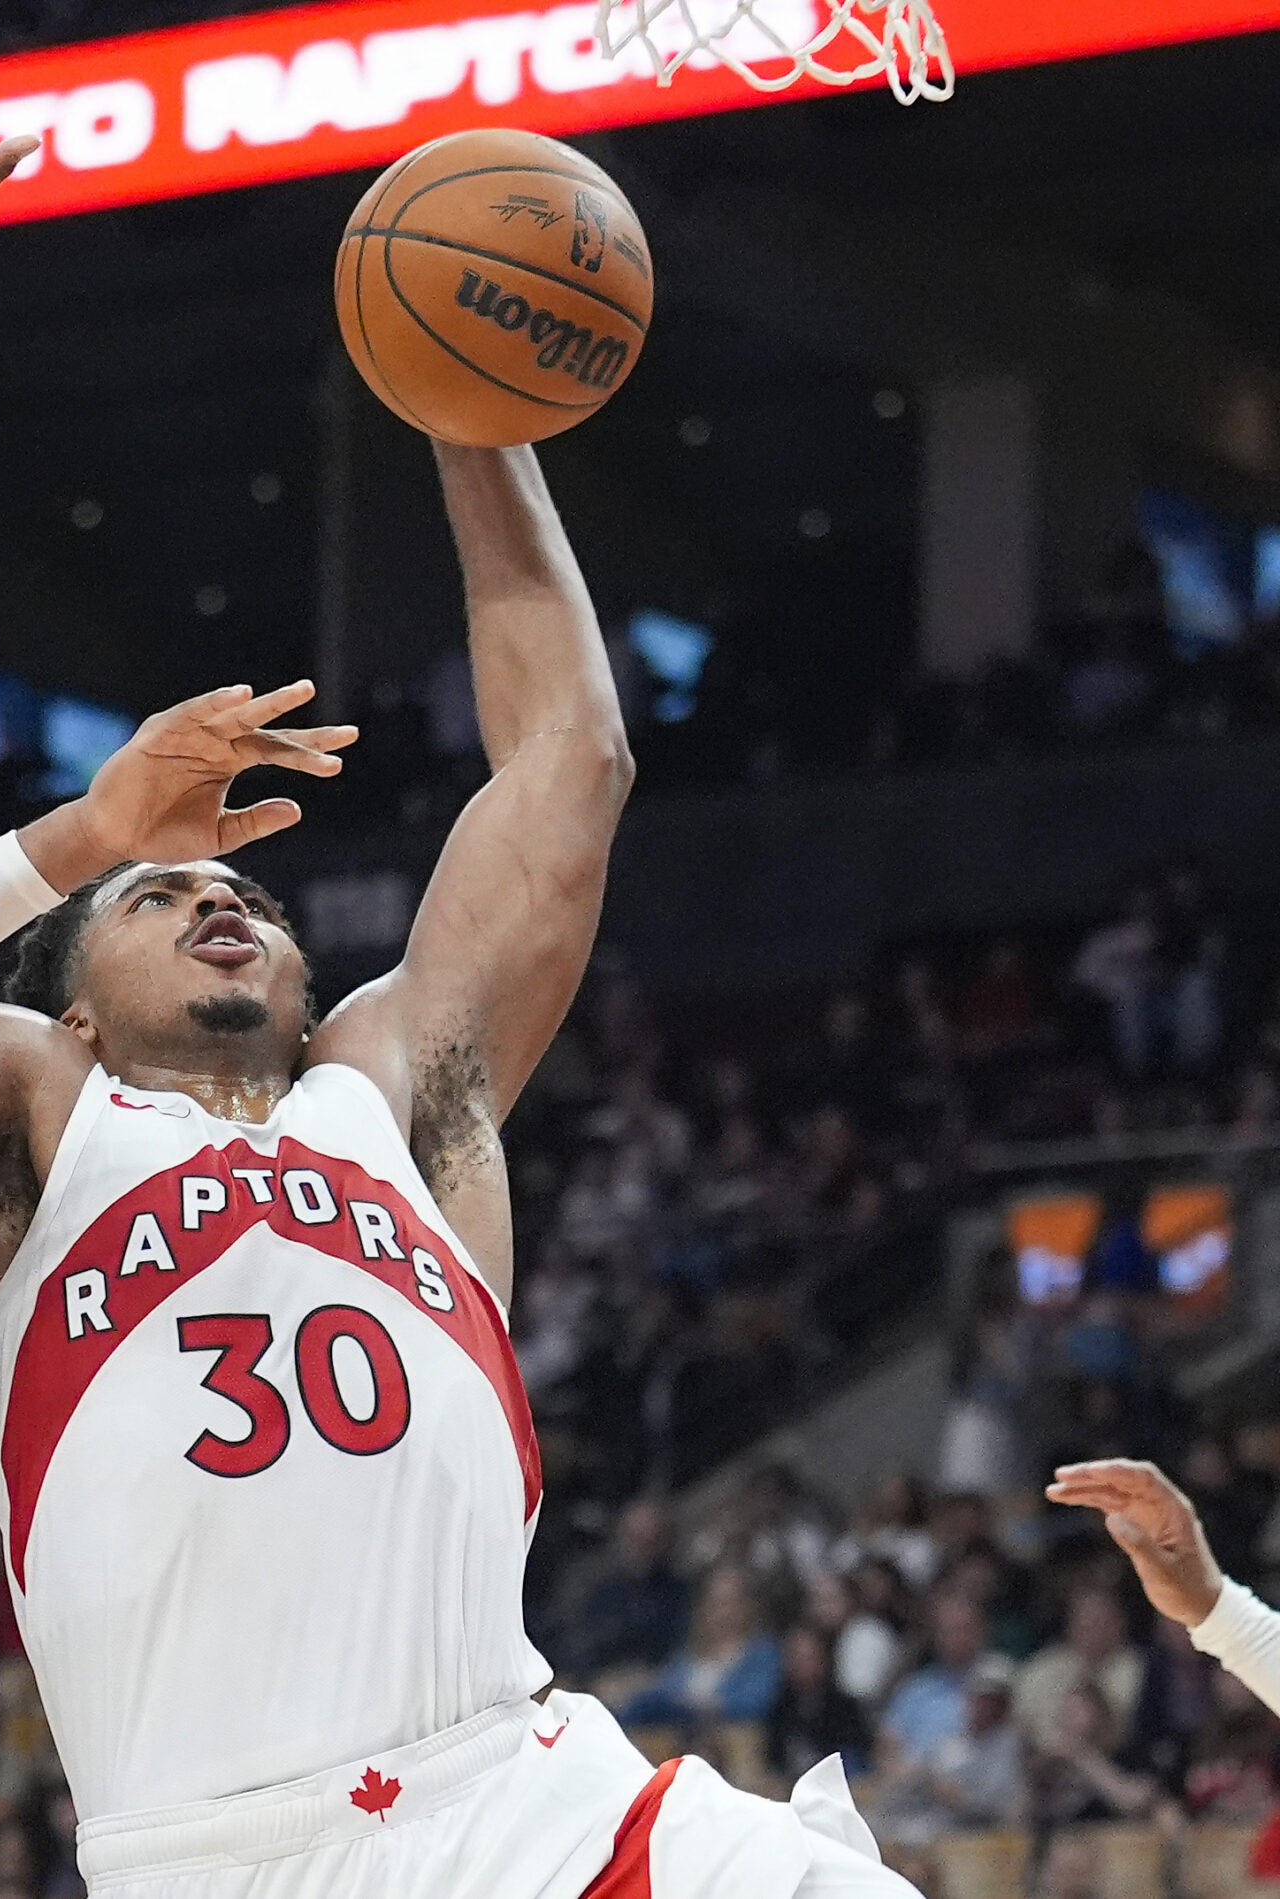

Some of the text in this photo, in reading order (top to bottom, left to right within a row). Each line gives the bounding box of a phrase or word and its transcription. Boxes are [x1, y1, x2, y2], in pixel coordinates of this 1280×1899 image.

[455, 267, 629, 389] Wilson
[63, 1167, 455, 1341] RAPTORS
[176, 1303, 412, 1479] 30
